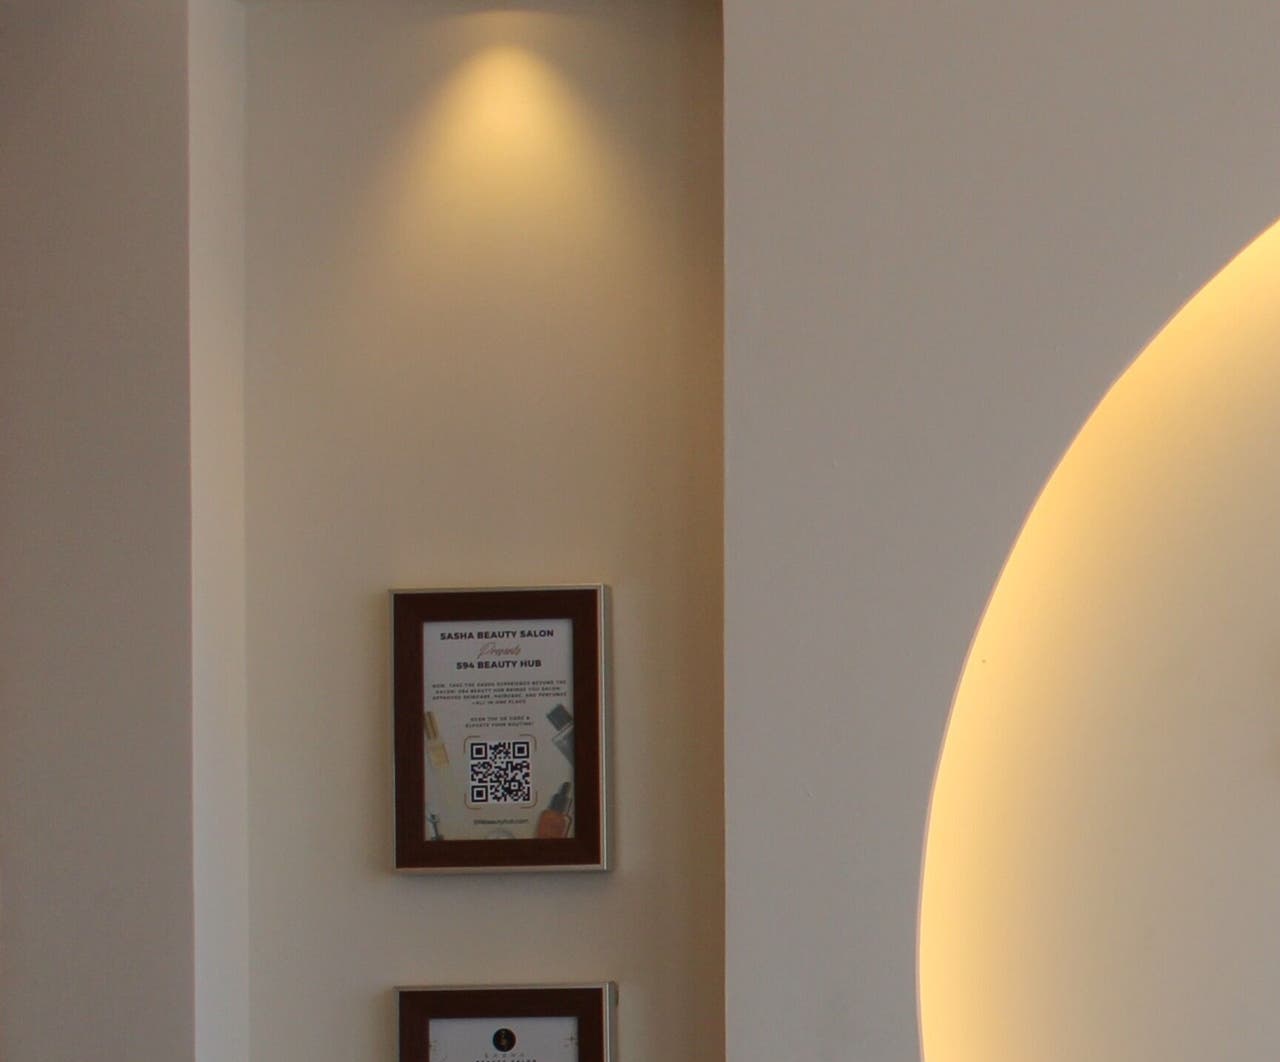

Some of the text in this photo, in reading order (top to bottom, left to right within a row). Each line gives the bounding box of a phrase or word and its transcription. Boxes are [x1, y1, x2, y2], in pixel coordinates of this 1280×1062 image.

[440, 630, 554, 641] SASHA BEAUTY SALON
[477, 660, 518, 669] BEAUTY
[520, 659, 542, 668] HUB
